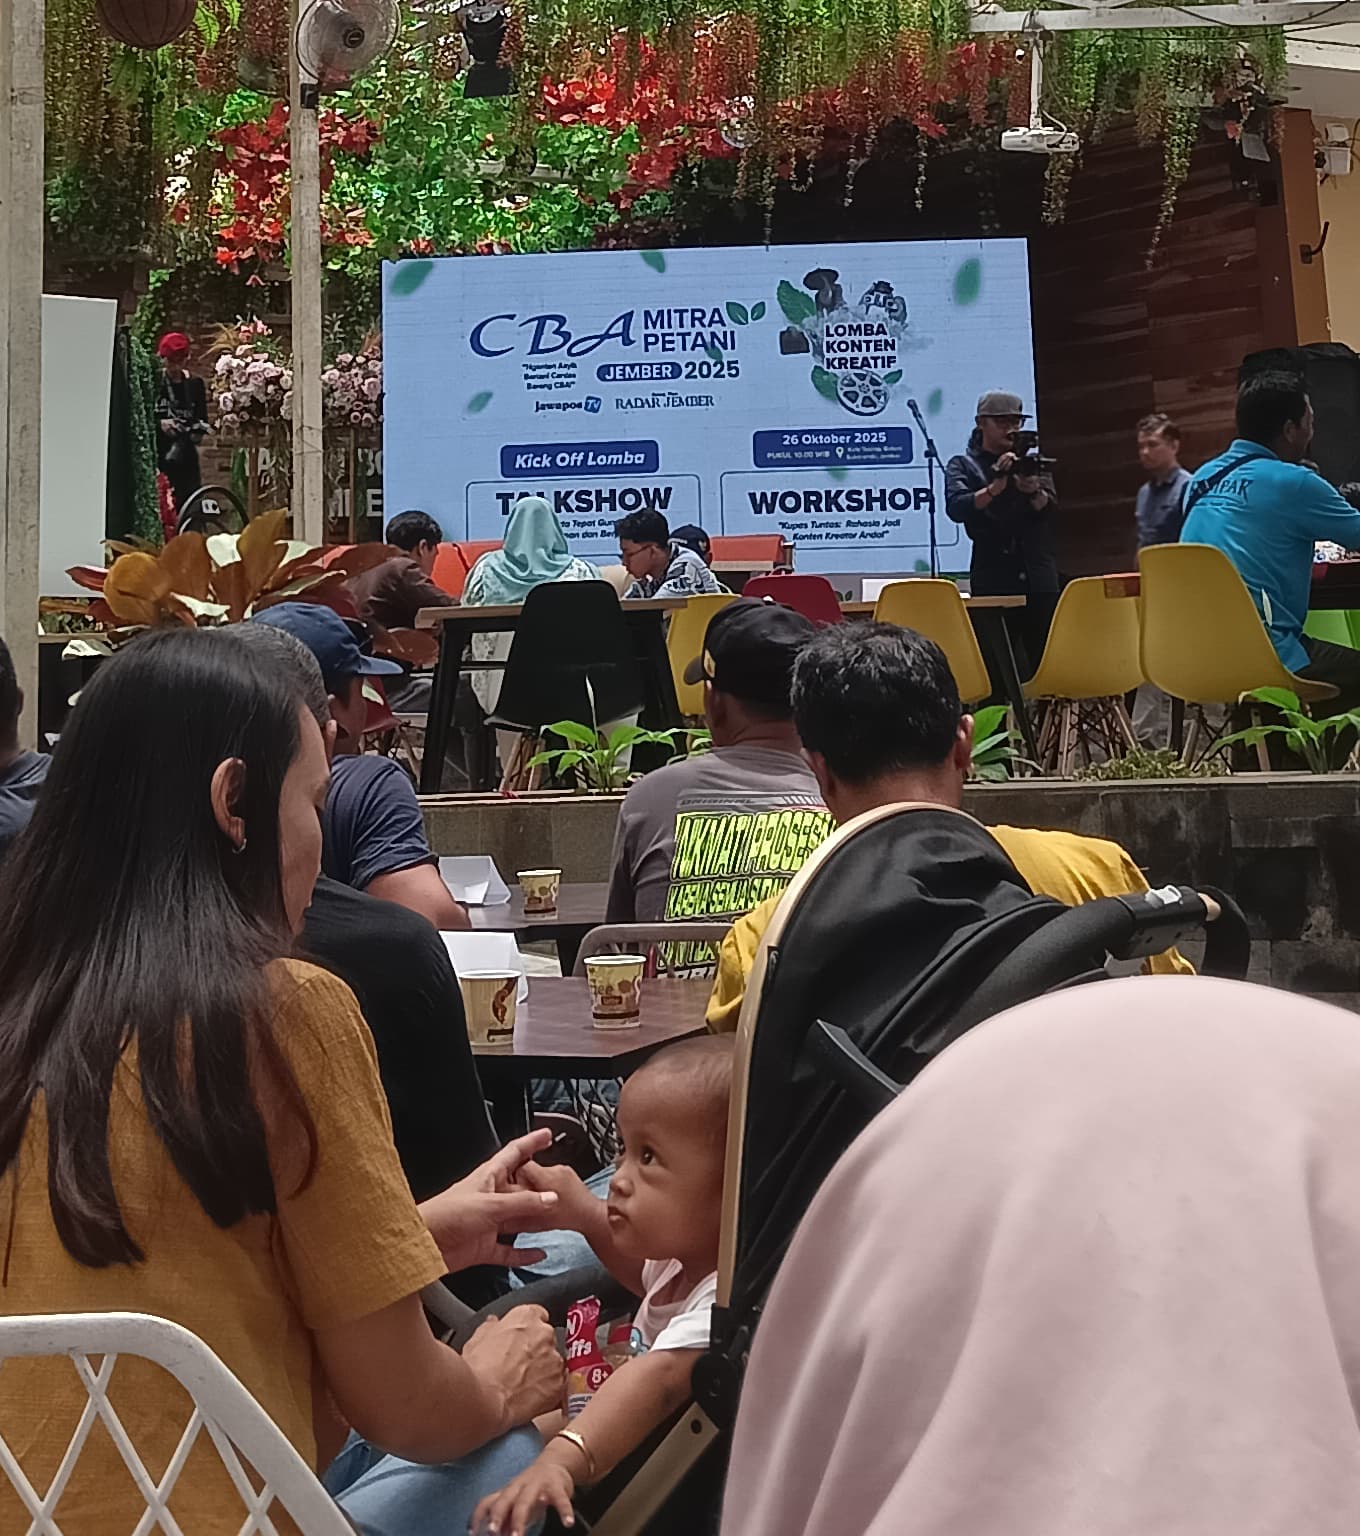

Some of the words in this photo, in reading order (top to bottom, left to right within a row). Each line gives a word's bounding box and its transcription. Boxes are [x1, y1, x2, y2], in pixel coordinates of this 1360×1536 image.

[469, 310, 636, 357] CBA
[643, 307, 727, 330] MITRA
[825, 323, 887, 337] LOMBA
[643, 330, 736, 352] PETANI
[825, 339, 896, 354] KONTEN
[605, 363, 673, 380] JEMBER
[684, 360, 740, 379] 2025
[825, 355, 897, 370] KREATIF
[615, 397, 660, 409] RADAR
[663, 395, 714, 408] JEMBER
[782, 434, 799, 445] 26
[802, 433, 850, 444] Oktober
[854, 432, 887, 443] 2025
[515, 454, 552, 469] Kick
[555, 451, 585, 467] Off
[587, 450, 645, 466] Lomba
[495, 487, 673, 516] TKSHOW
[748, 487, 933, 514] WORKSHOP
[592, 1368, 608, 1383] 8+
